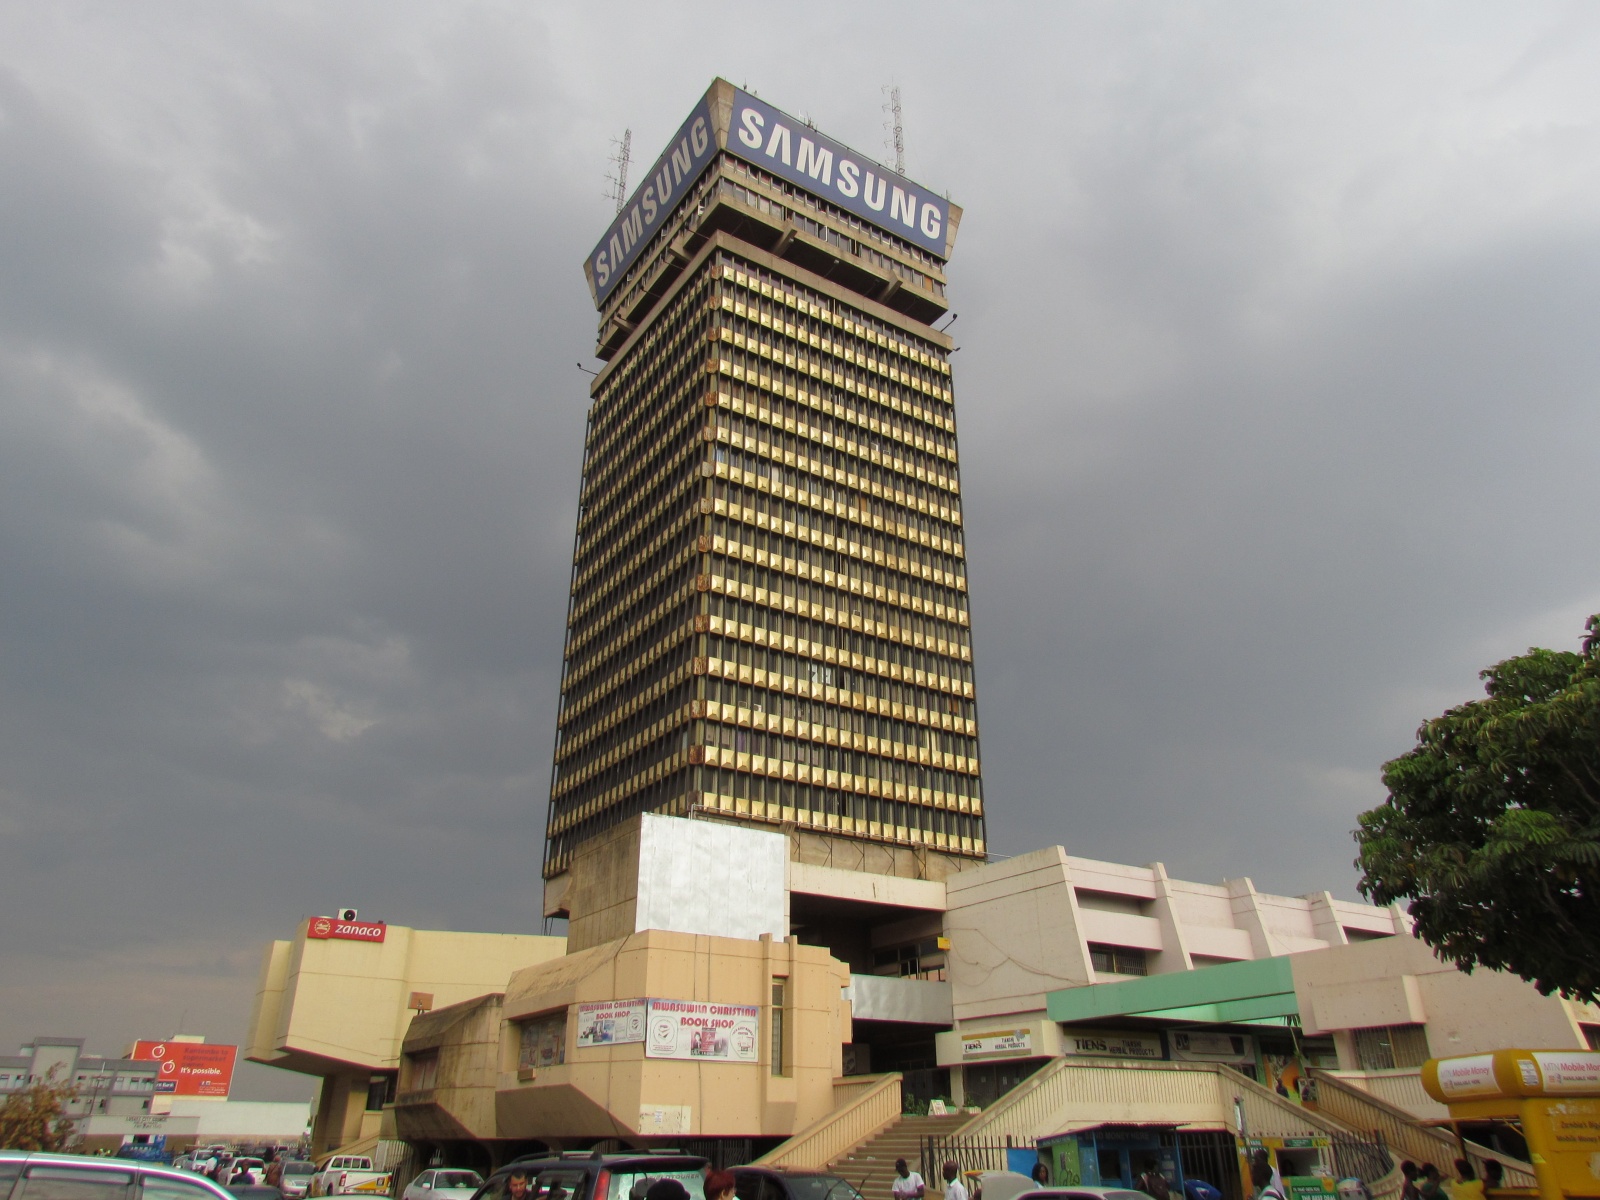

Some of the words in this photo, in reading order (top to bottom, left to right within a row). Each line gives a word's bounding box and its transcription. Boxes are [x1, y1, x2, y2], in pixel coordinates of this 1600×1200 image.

[738, 107, 942, 240] SAMSUNG
[595, 116, 709, 288] SAMSUNG
[335, 924, 382, 937] zanaco
[614, 1000, 645, 1009] CHRISTIAN
[652, 1001, 708, 1014] MWASUWILA
[709, 1005, 757, 1017] CHRISTIAN
[595, 1011, 614, 1020] BOOK
[614, 1010, 631, 1019] SHOP
[680, 1017, 709, 1028] BOOK
[711, 1019, 735, 1029] SHOP
[965, 1042, 982, 1050] TIENS
[1074, 1037, 1107, 1051] TIENS
[1128, 1047, 1155, 1056] PRODUCTS
[180, 1066, 191, 1074] It's
[192, 1067, 222, 1075] possible.
[1452, 1068, 1470, 1077] Mobile
[1471, 1066, 1490, 1076] Money
[1543, 1063, 1561, 1072] MTN
[1560, 1062, 1586, 1072] Mobile
[1105, 1130, 1130, 1140] MONEY
[1130, 1130, 1150, 1140] HERE
